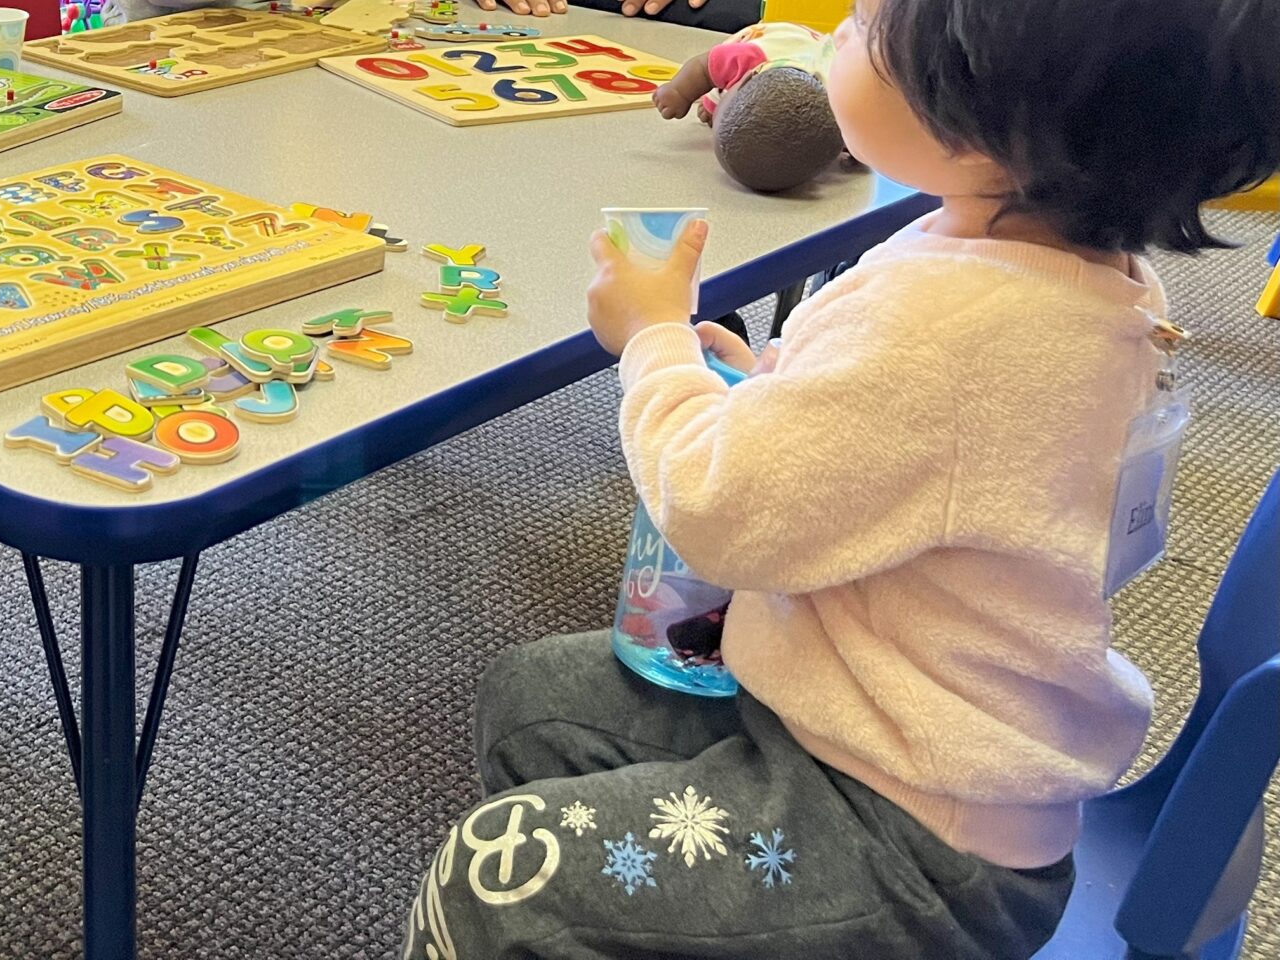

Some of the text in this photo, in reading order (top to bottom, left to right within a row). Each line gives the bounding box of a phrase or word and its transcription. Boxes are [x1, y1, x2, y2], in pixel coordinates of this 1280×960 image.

[356, 39, 637, 80] 0 1 2 3 4
[413, 83, 499, 111] 5
[491, 78, 559, 104] 6
[522, 74, 588, 101] 7
[574, 69, 659, 94] 8
[34, 171, 87, 192] F
[85, 162, 151, 180] G
[9, 211, 81, 231] L
[59, 191, 150, 218] M
[123, 178, 204, 201] N
[52, 228, 132, 251] R
[117, 209, 184, 235] S
[164, 195, 234, 217] T
[29, 259, 125, 290] W
[113, 242, 201, 270] X
[172, 227, 244, 250] Y
[228, 213, 310, 238] Z
[439, 264, 502, 292] R
[125, 353, 209, 389] D
[64, 387, 155, 437] P
[155, 410, 240, 455] O
